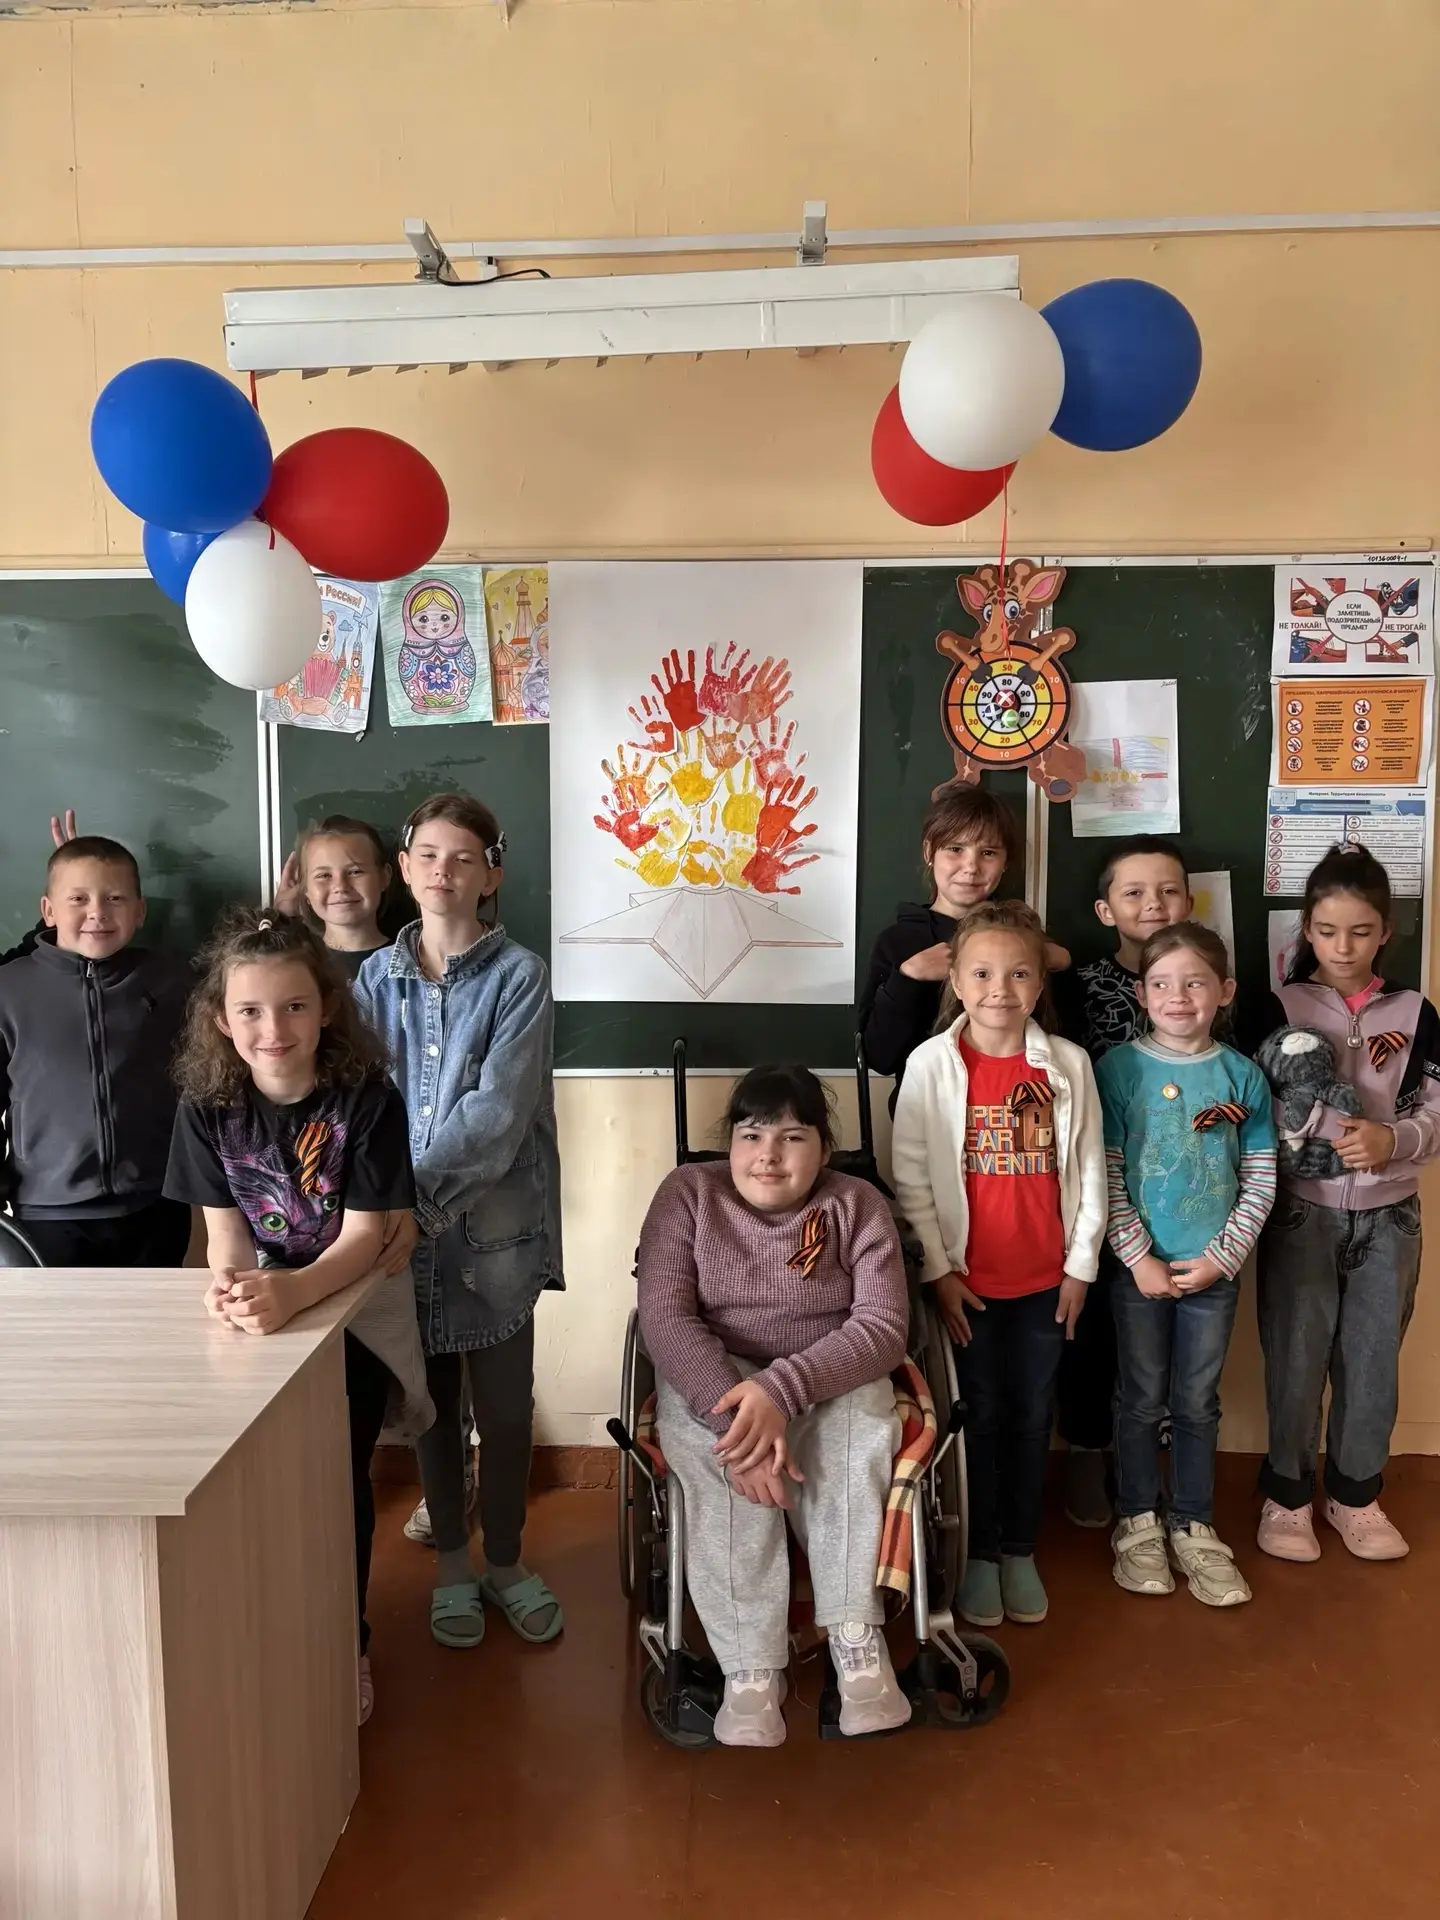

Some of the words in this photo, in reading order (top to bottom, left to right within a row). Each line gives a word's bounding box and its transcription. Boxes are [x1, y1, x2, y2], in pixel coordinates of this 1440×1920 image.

[1290, 621, 1322, 629] ТОЛКАЙ!
[1396, 622, 1427, 630] ТРОГАЙ!
[966, 1129, 1014, 1152] EAR
